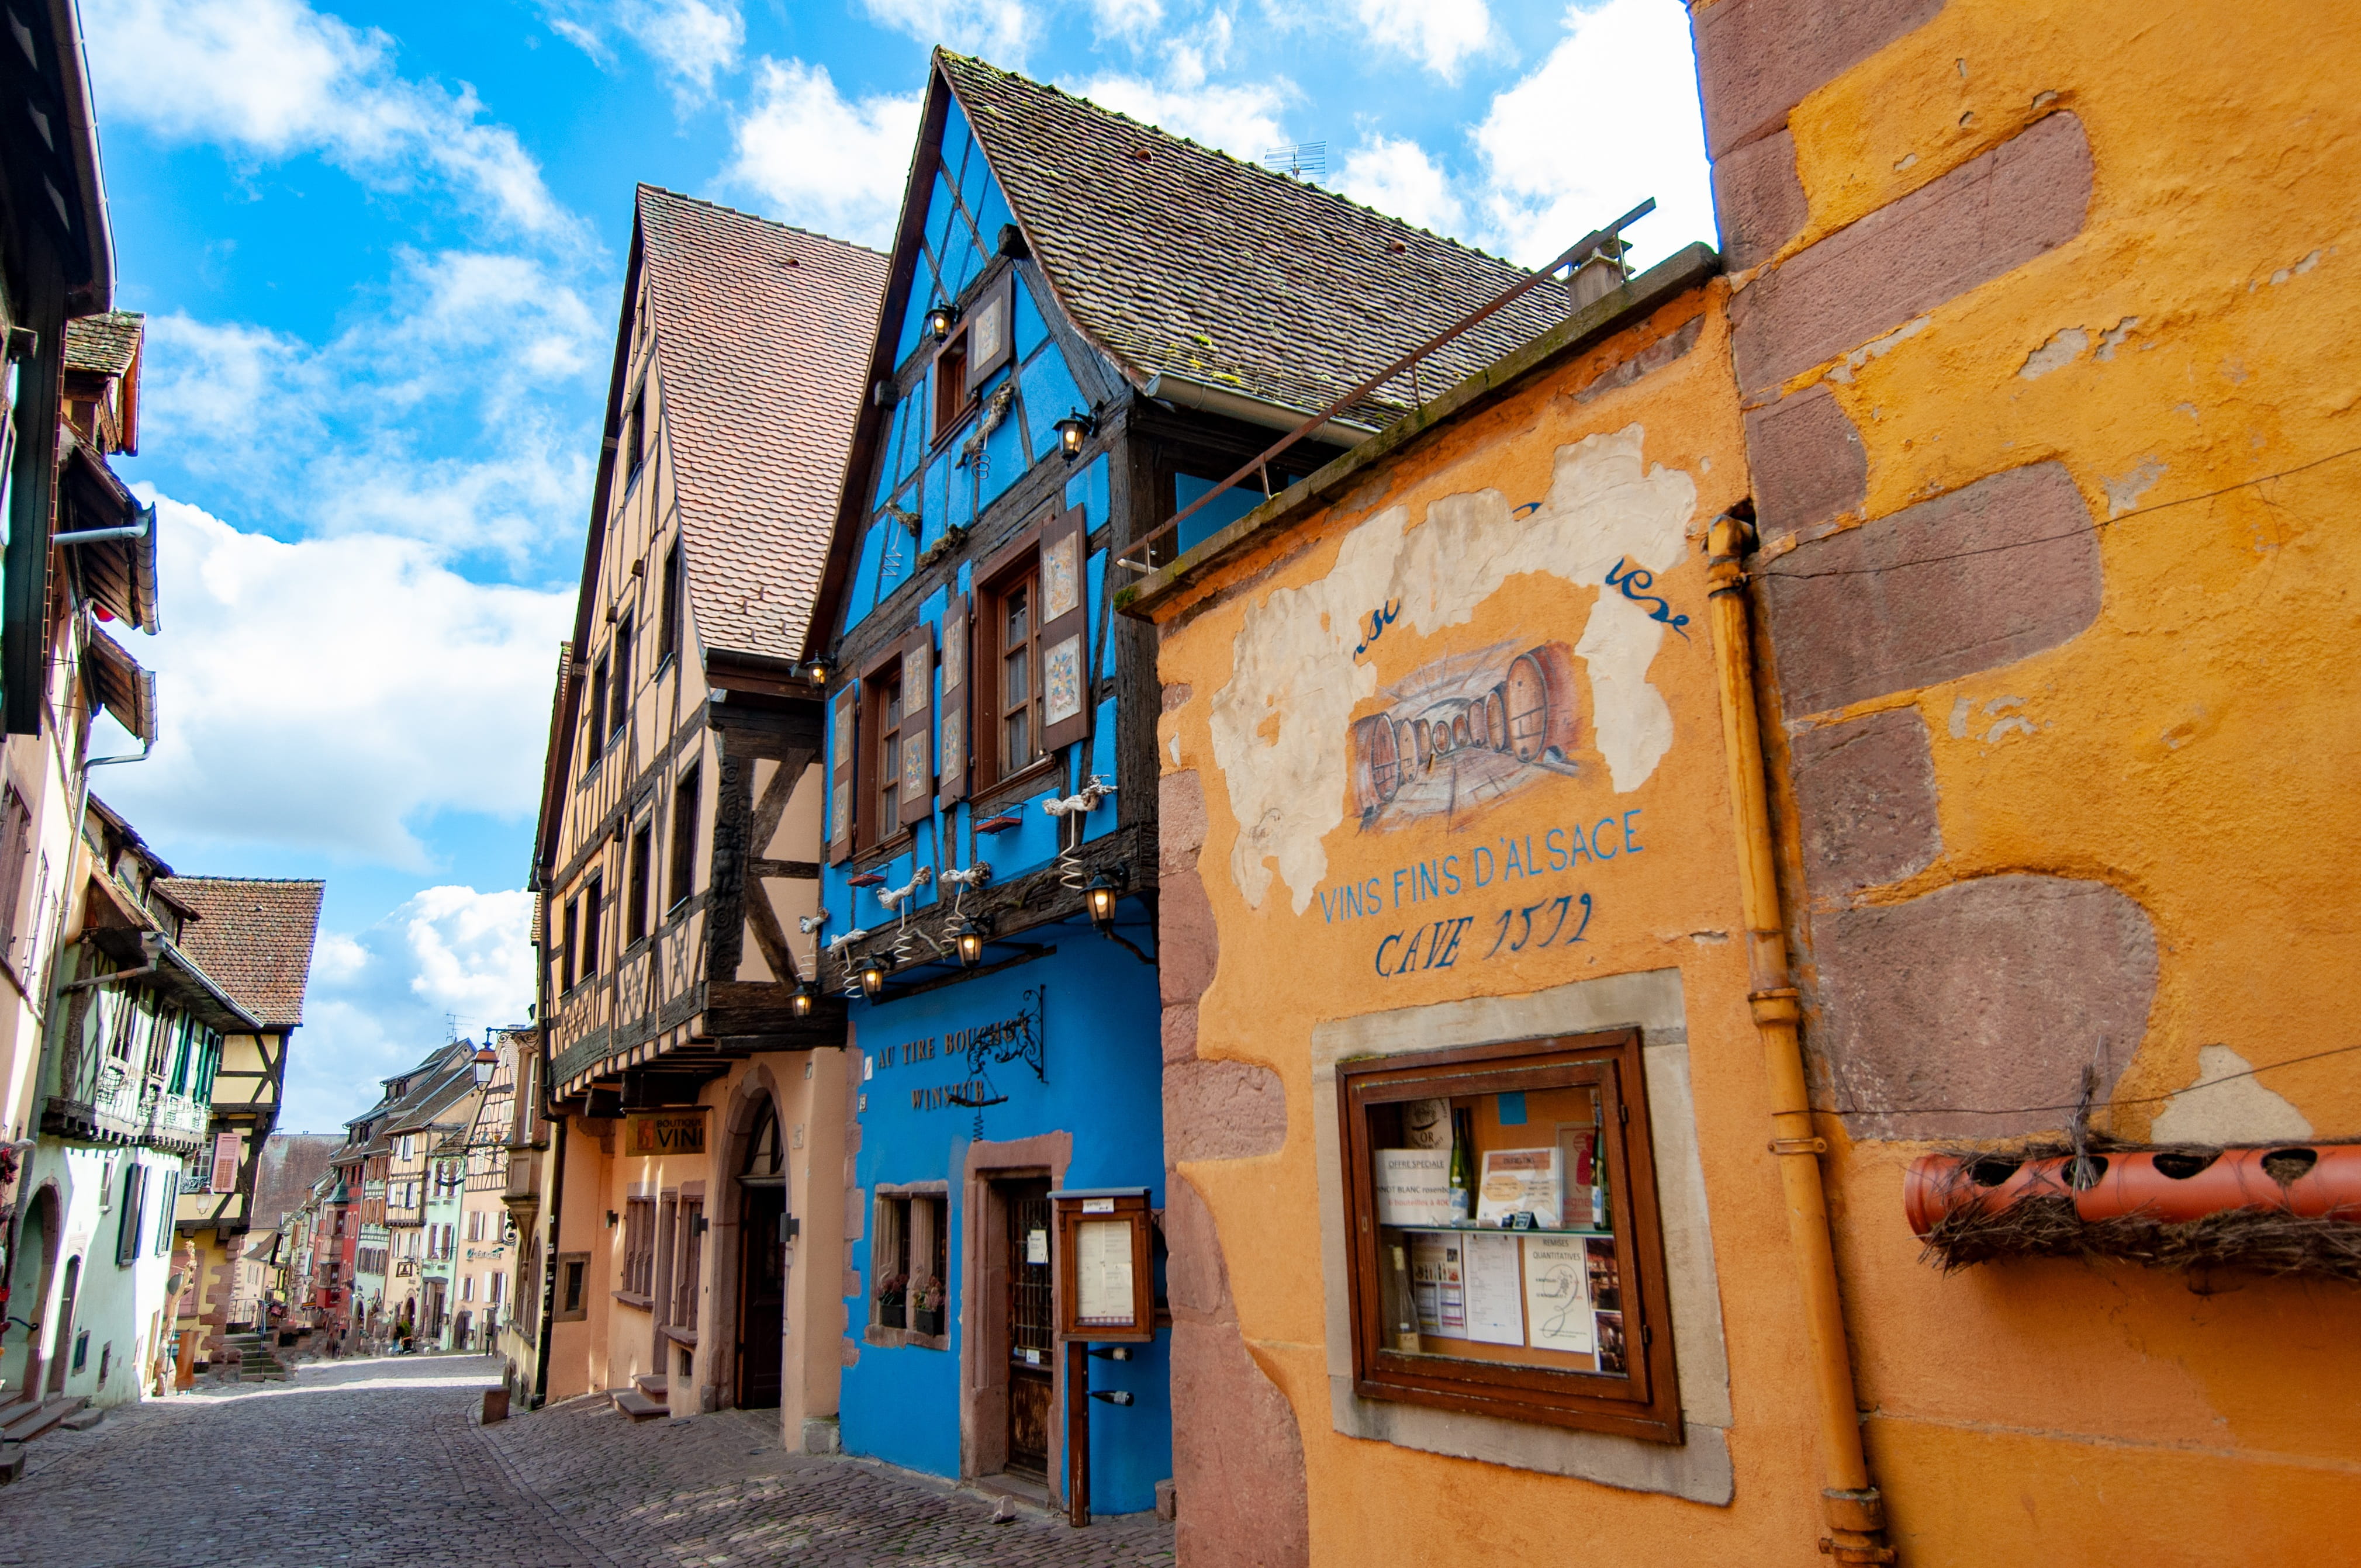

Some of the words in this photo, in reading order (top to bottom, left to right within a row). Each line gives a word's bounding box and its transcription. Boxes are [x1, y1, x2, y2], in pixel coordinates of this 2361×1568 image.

[1319, 878, 1382, 925] VINS
[1394, 855, 1461, 908] FINS
[1473, 809, 1644, 888] D'ALSACE
[1375, 916, 1474, 983] CAVE
[1482, 892, 1592, 961] 1572
[878, 1046, 895, 1068] AU
[902, 1036, 935, 1064] TIRE
[911, 1080, 984, 1110] WINSTUB
[656, 1118, 703, 1128] BOUTIQUE
[657, 1127, 703, 1148] VINI
[1420, 1131, 1434, 1143] OR
[1543, 1238, 1570, 1247] REMISES
[1533, 1251, 1581, 1261] QUANTITATIVES
